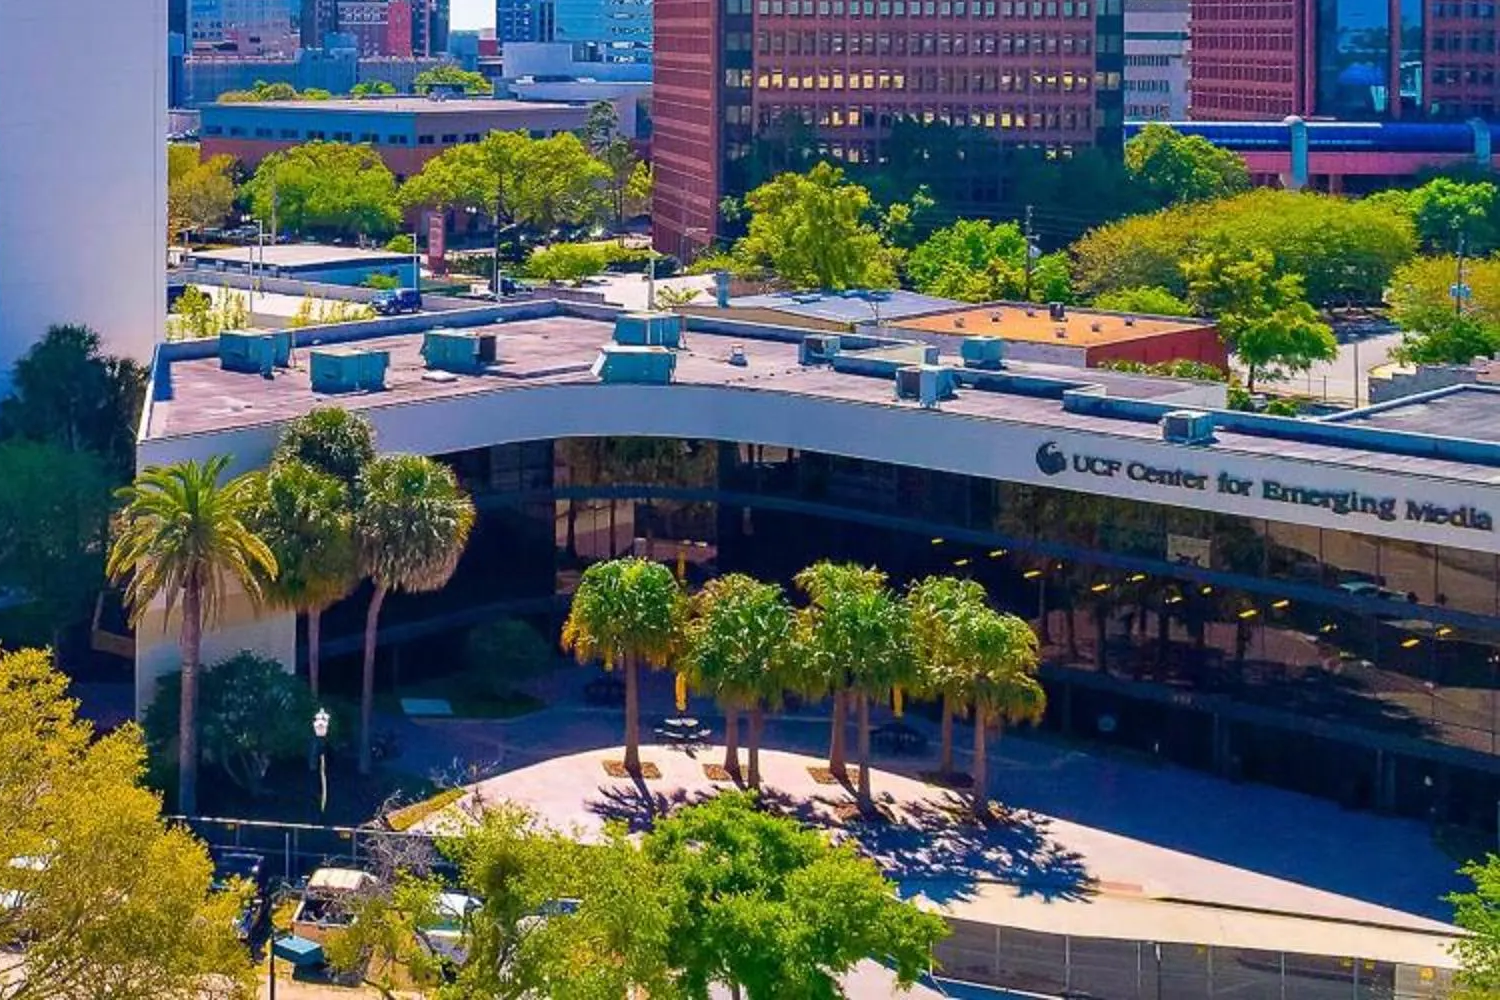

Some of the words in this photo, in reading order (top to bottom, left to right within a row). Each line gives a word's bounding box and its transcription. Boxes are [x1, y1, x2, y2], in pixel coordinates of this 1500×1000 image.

[1073, 454, 1122, 477] UCF
[1127, 462, 1208, 490] Center
[1217, 471, 1253, 496] for
[1263, 478, 1397, 521] Emerging
[1406, 499, 1493, 530] Media
